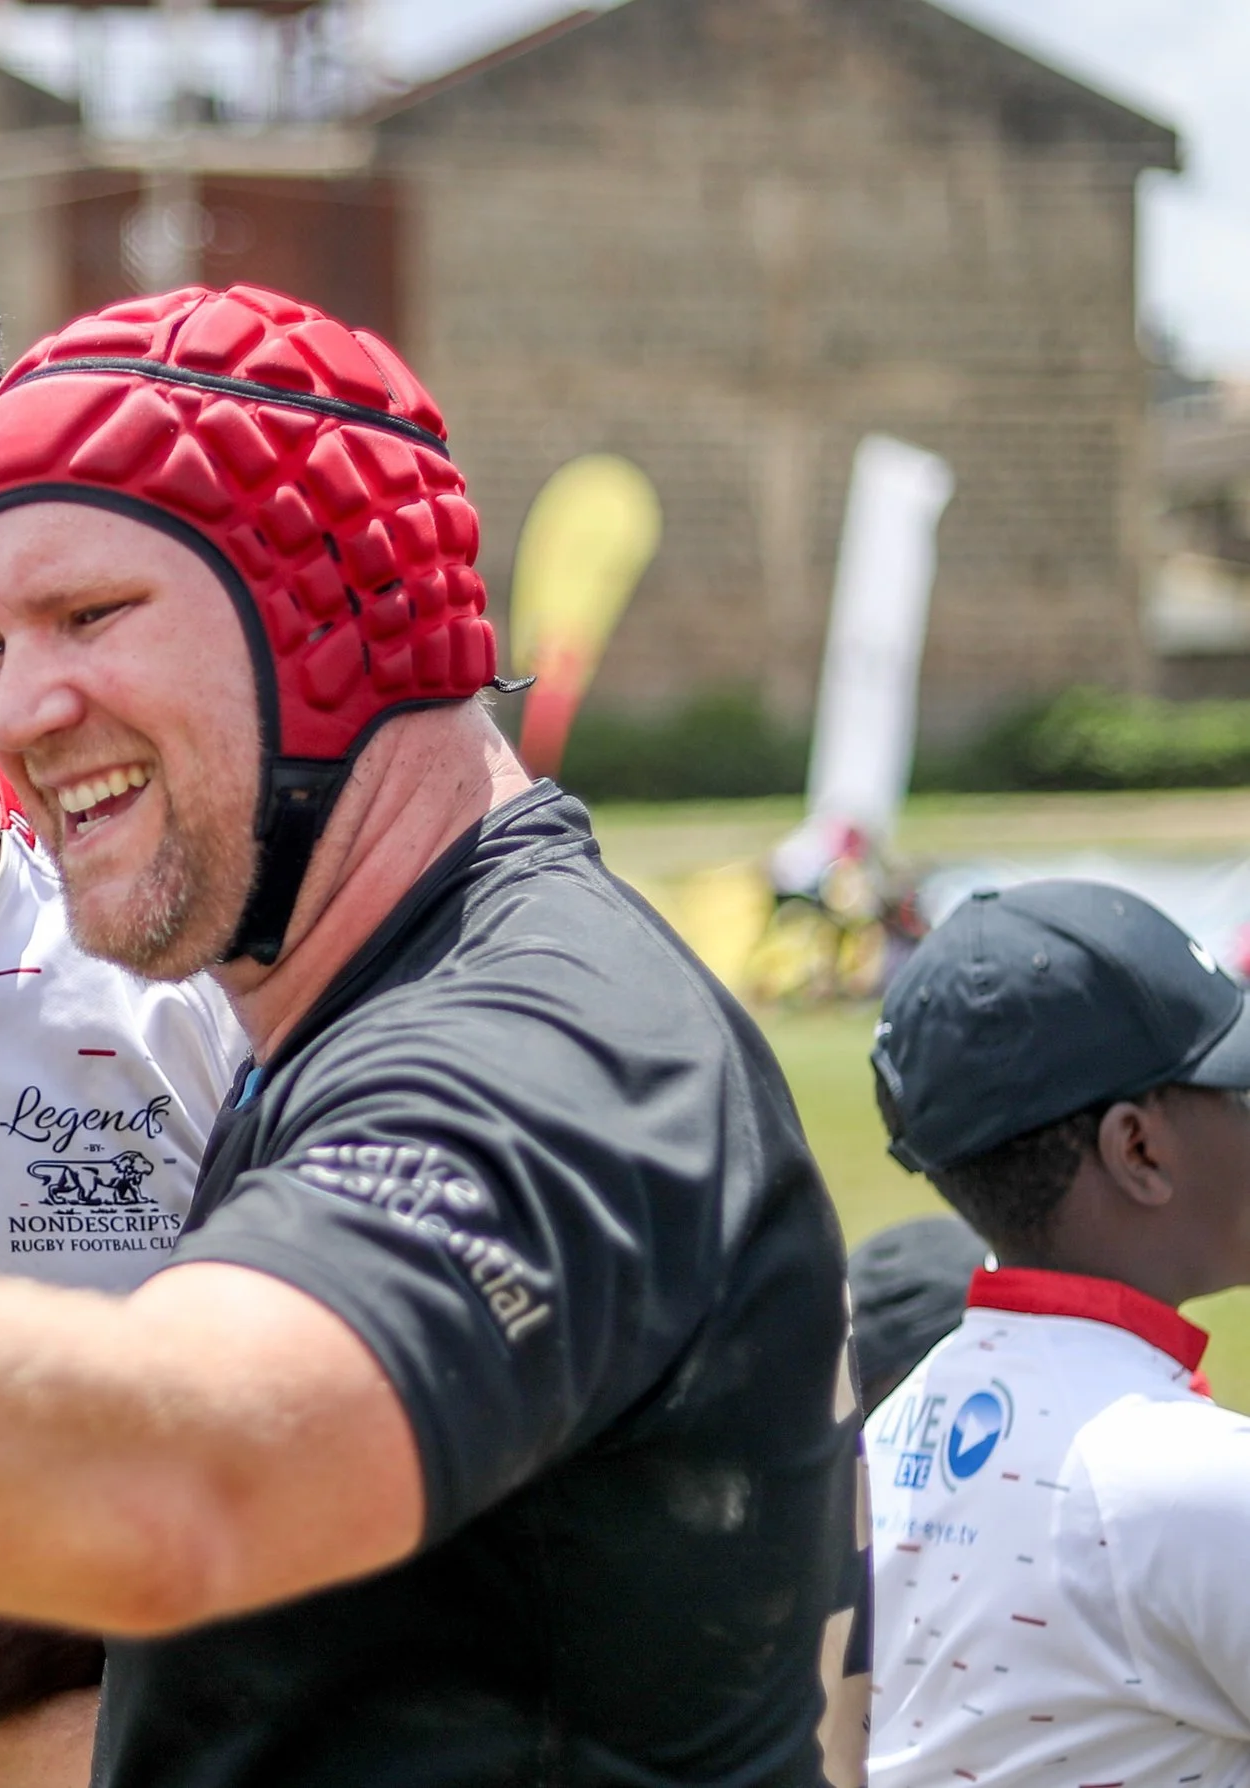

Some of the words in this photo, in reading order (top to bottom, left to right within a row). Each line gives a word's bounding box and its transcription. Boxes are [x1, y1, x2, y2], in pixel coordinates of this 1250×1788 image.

[0, 1085, 171, 1153] Legends
[8, 1213, 181, 1233] NONDESCRIPTS
[10, 1239, 65, 1252] RUGBY
[70, 1237, 147, 1251] FOOTBALL
[150, 1236, 177, 1250] CLU
[876, 1396, 947, 1449] LIVE
